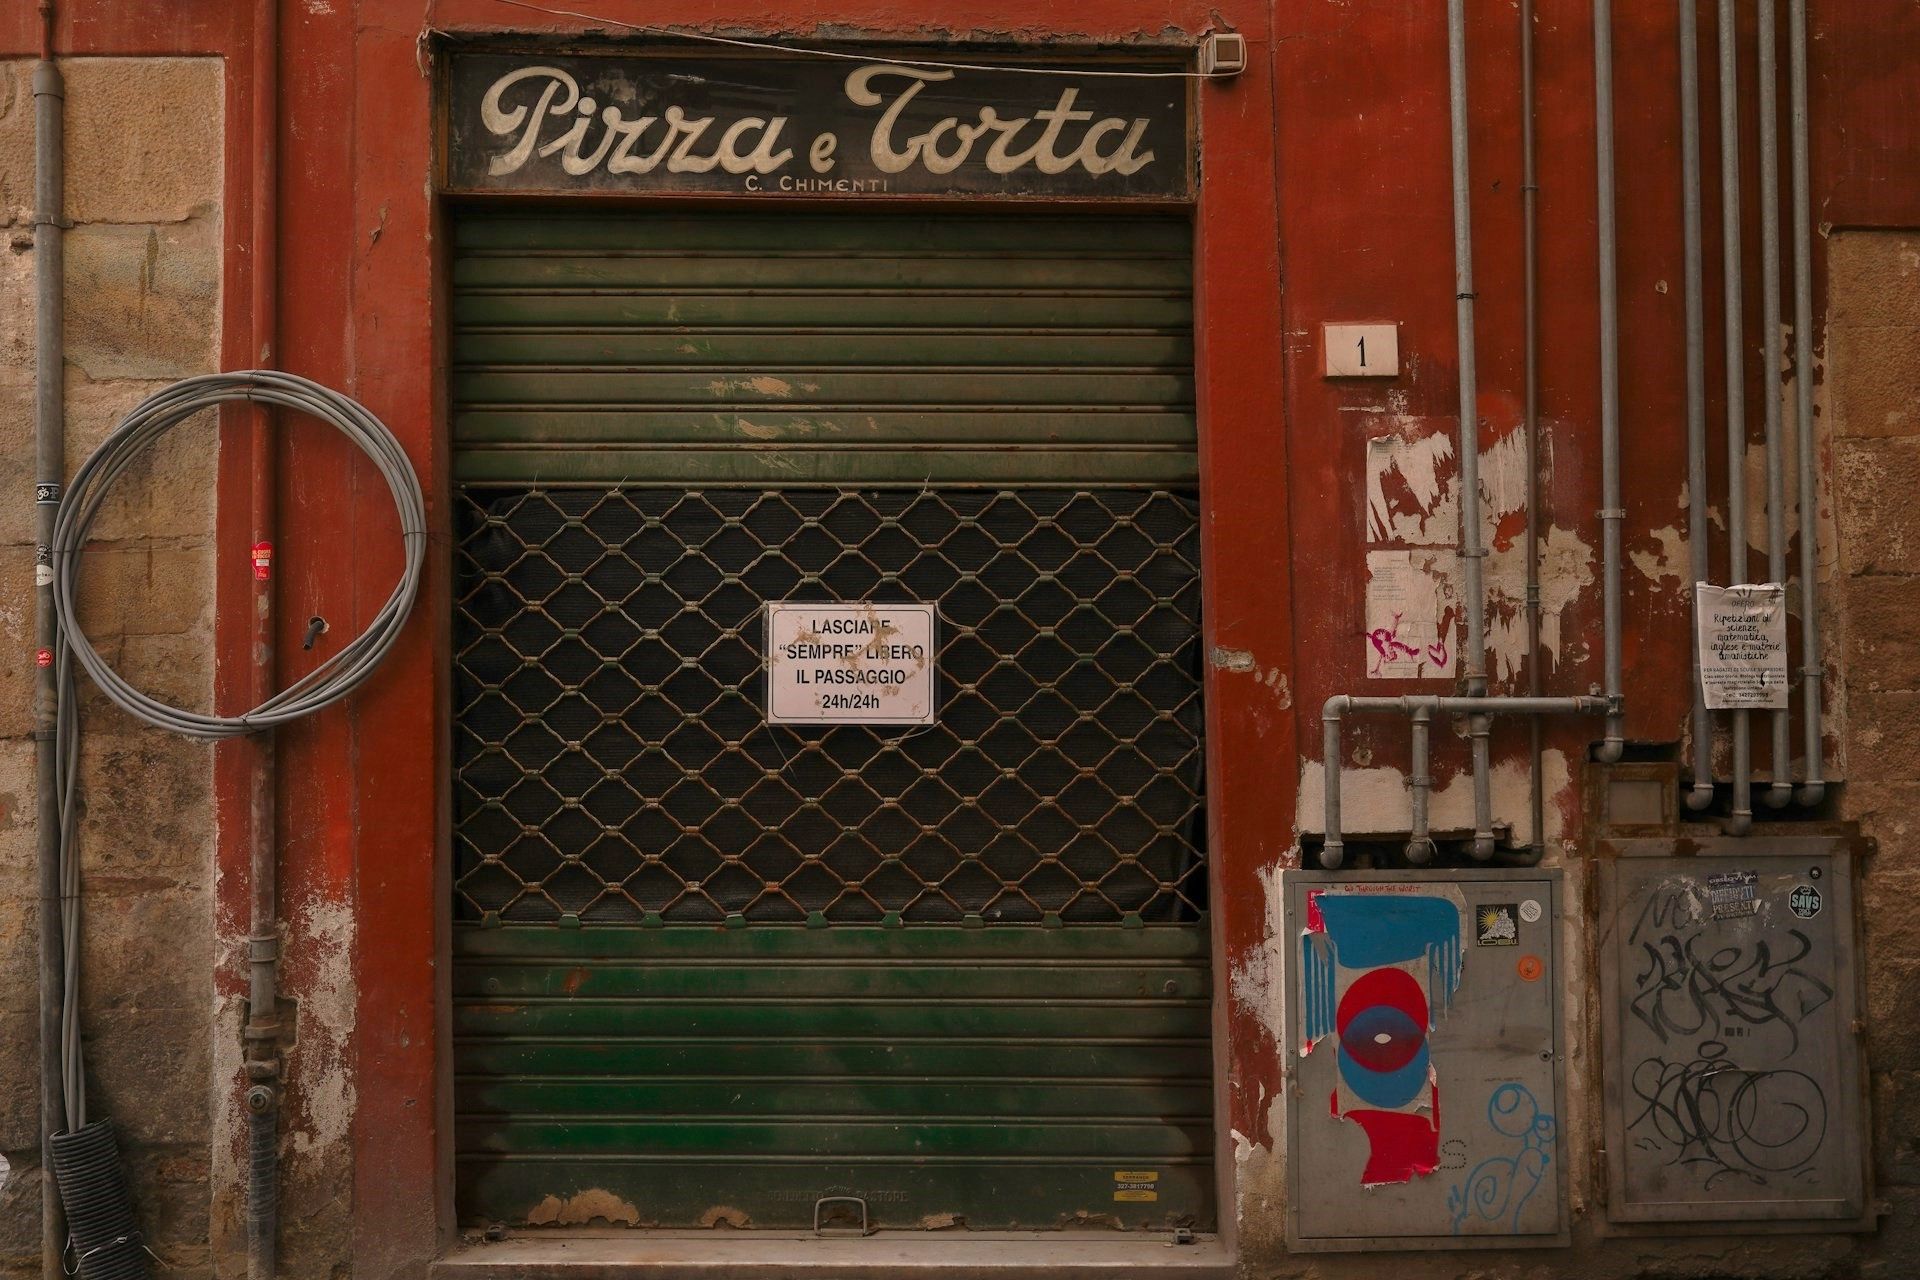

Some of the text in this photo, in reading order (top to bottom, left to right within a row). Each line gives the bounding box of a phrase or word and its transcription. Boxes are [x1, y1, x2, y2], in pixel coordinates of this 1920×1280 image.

[481, 64, 1156, 175] Pizza e Torta
[745, 175, 888, 192] C. CHIMENTI
[1357, 335, 1367, 367] 1
[1714, 613, 1760, 626] Ripetizioni
[1726, 625, 1760, 634] scienze,
[1717, 633, 1769, 643] matematica,
[866, 645, 924, 660] LIBERO
[1710, 642, 1739, 652] inglese
[1749, 641, 1781, 651] materie
[796, 669, 906, 685] IL PASSAGGIO
[822, 694, 880, 709] 24h/24h
[1791, 894, 1820, 910] SAVS
